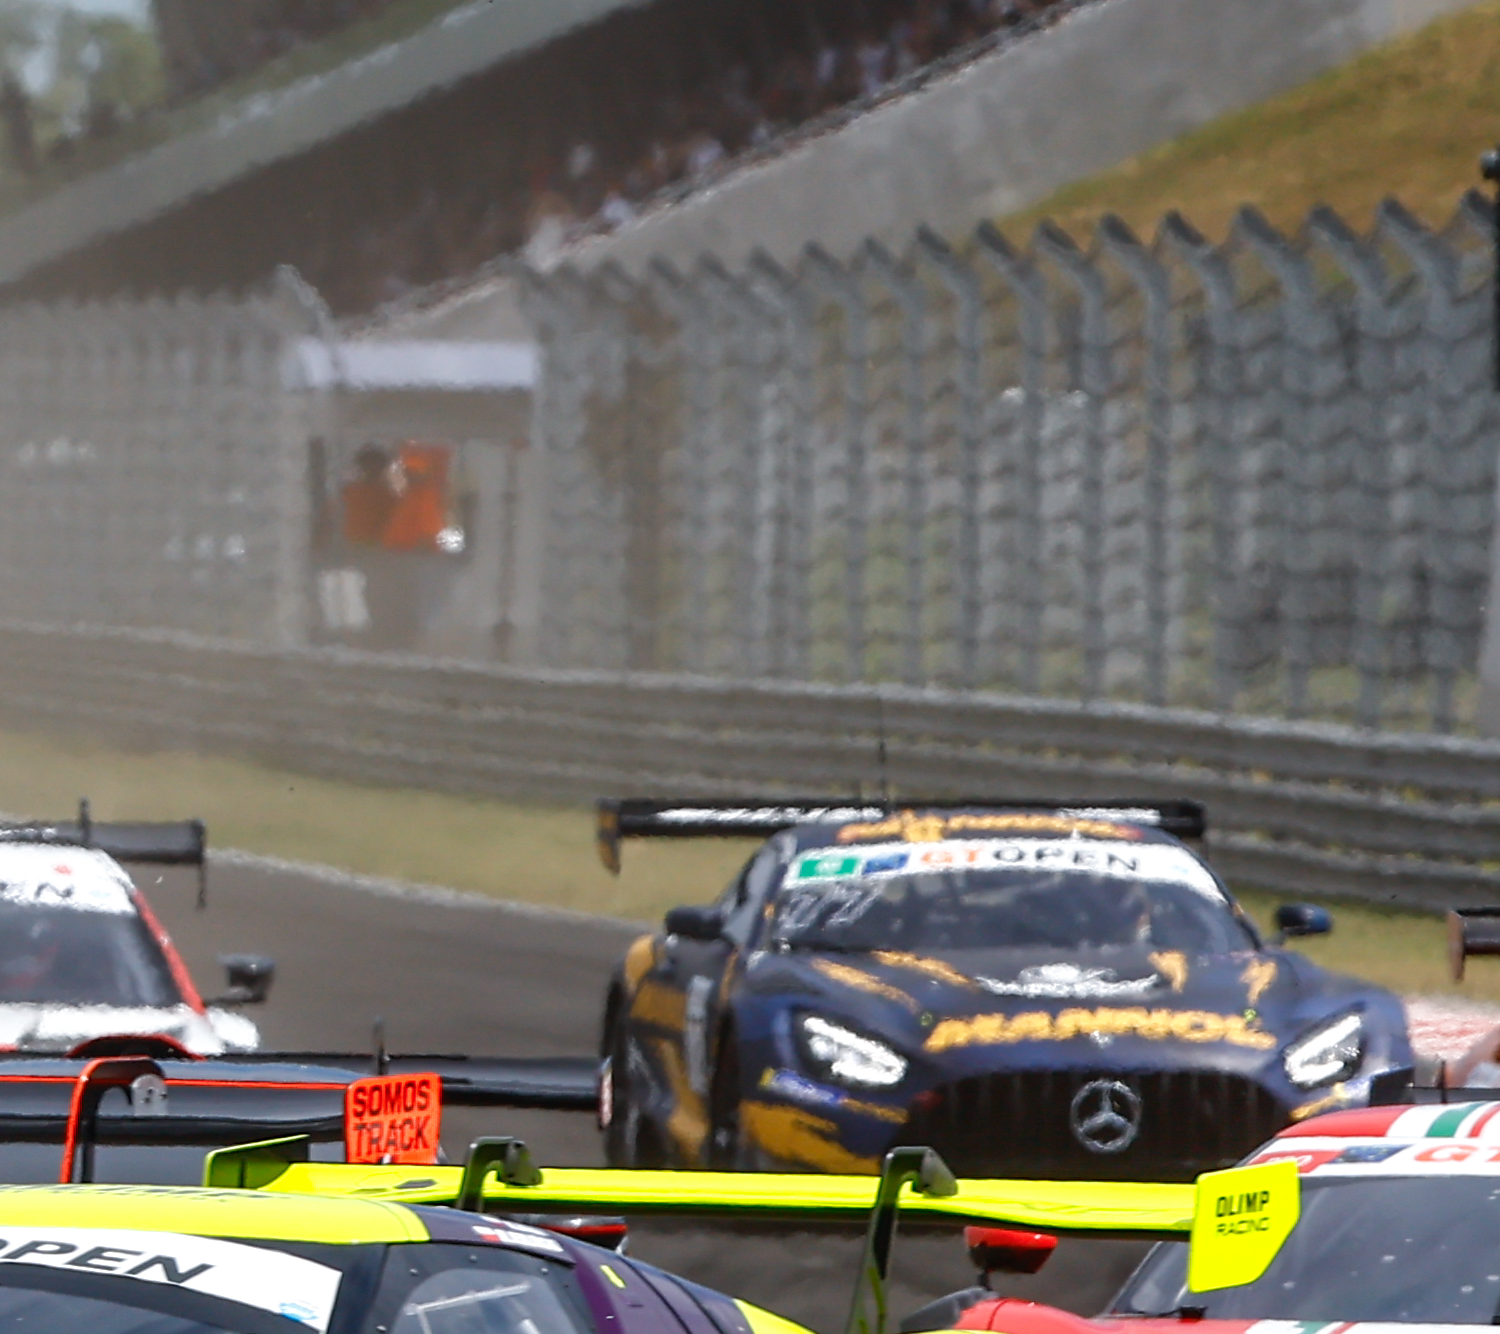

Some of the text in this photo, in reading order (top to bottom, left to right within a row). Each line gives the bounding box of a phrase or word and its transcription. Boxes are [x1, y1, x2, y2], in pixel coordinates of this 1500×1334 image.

[353, 1079, 431, 1118] SOMOS
[354, 1115, 430, 1157] TRACK
[1216, 1190, 1269, 1218] OLIMP
[1215, 1217, 1269, 1237] RACING
